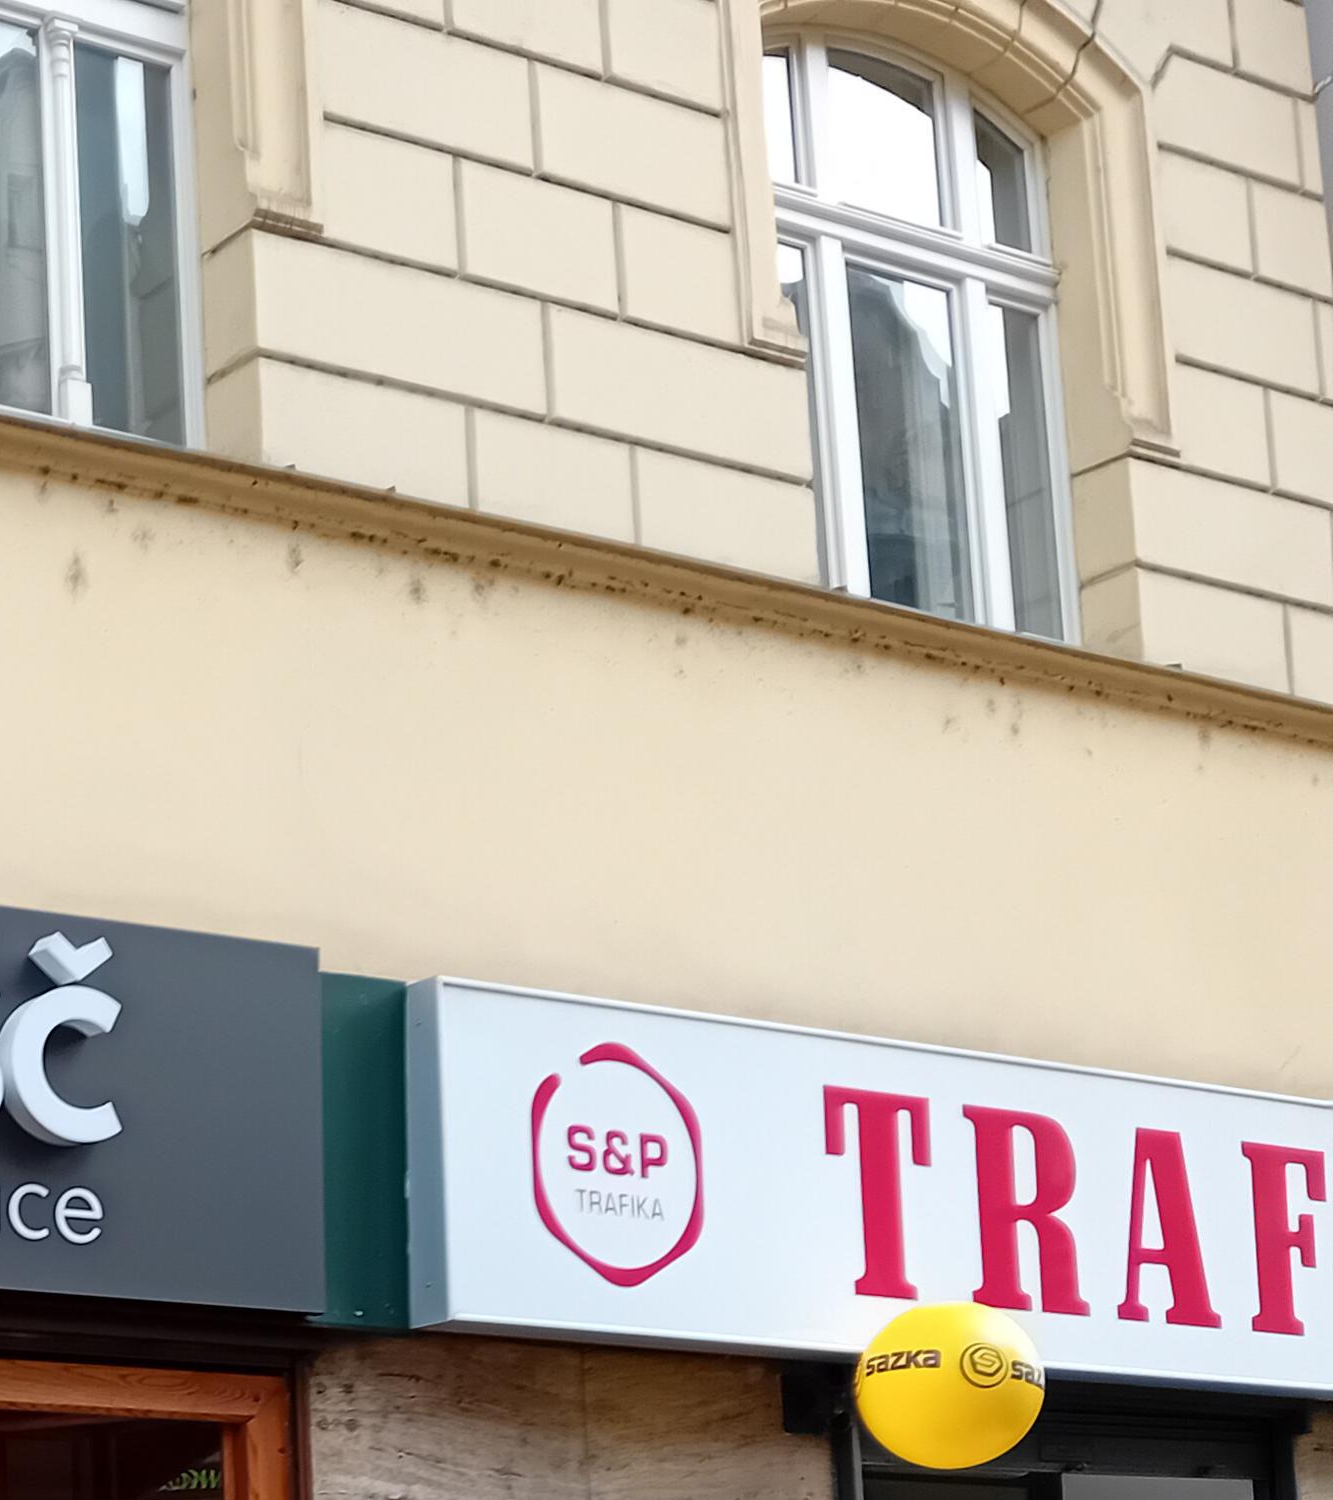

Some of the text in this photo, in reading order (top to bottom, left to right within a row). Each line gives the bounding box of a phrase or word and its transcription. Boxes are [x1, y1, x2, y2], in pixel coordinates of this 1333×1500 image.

[566, 1123, 669, 1179] S&P
[574, 1187, 665, 1221] TRAFIKA
[822, 1083, 1328, 1338] TRAF
[865, 1350, 942, 1378] sazka
